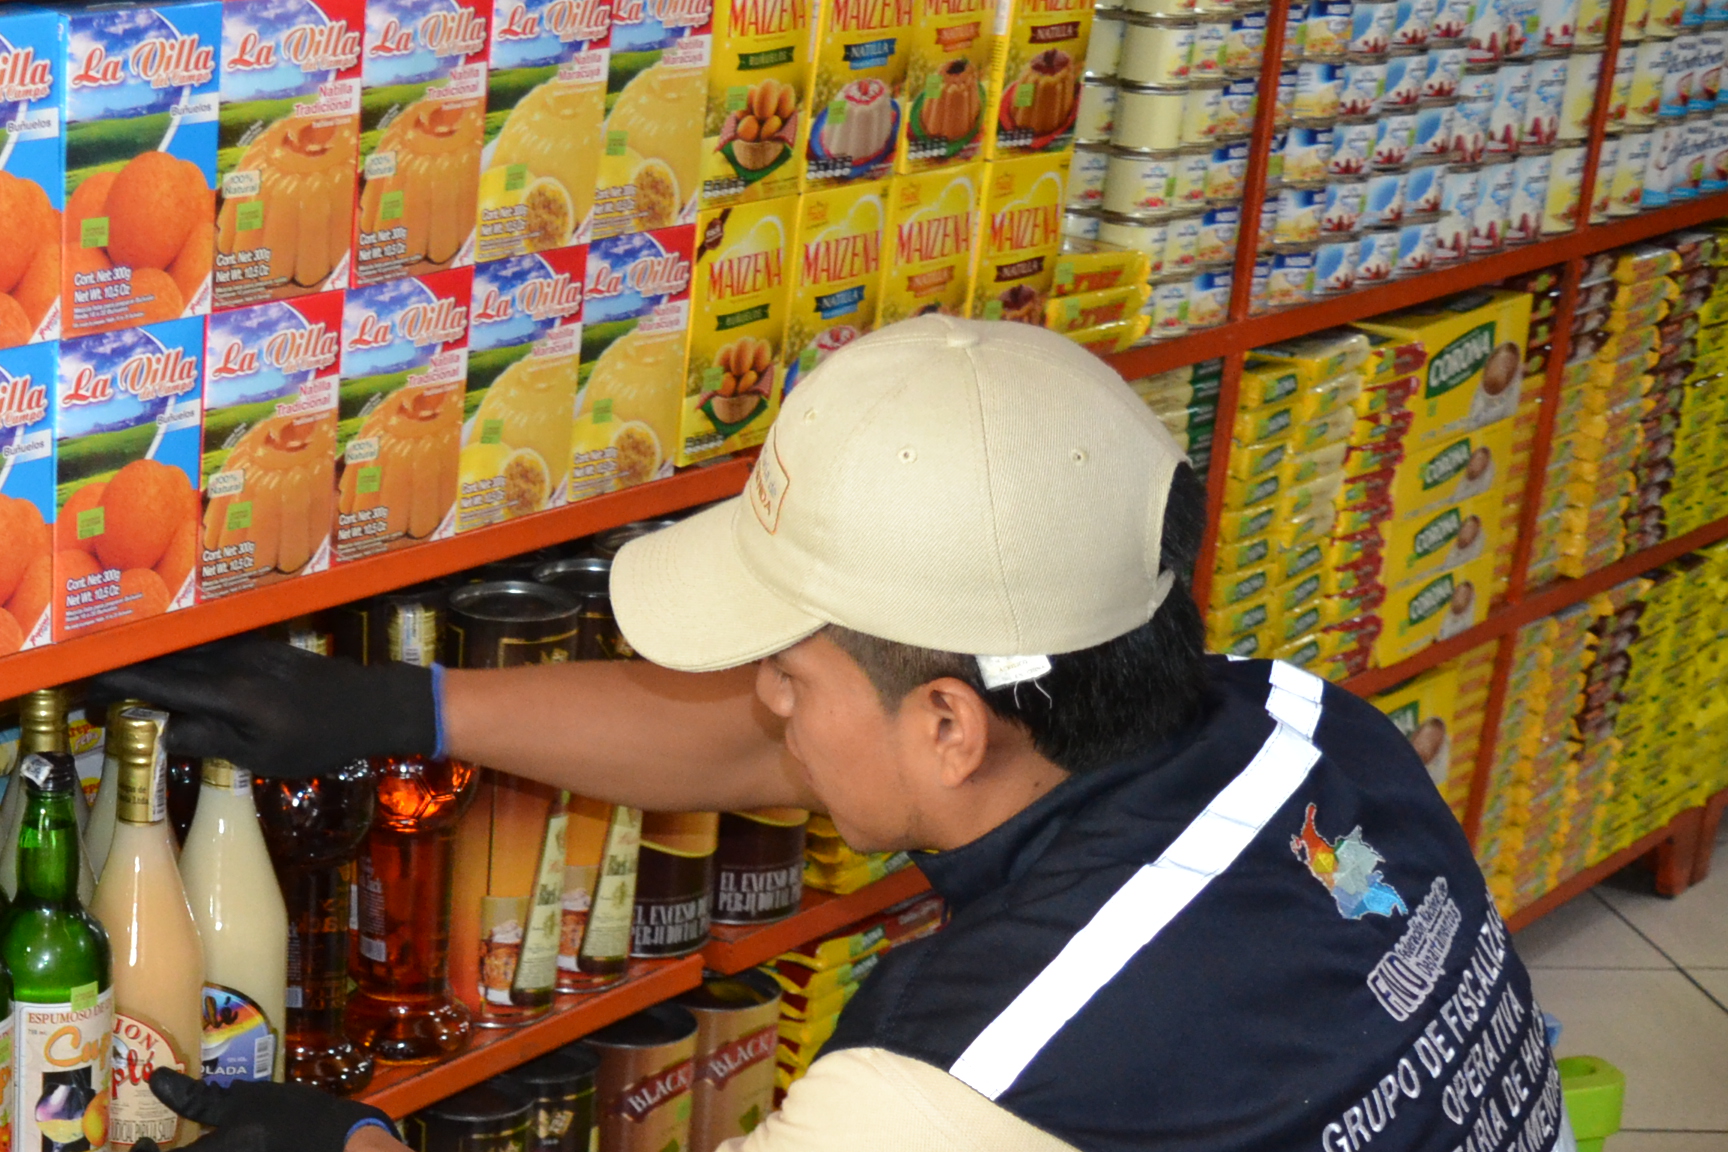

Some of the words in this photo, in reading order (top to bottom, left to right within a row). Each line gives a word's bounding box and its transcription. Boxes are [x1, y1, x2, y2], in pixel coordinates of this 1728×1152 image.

[372, 20, 413, 57] La
[419, 8, 486, 53] Villa
[497, 4, 539, 41] La
[544, 0, 612, 36] Villa
[728, 0, 806, 38] MAIZENA
[831, 0, 913, 32] MAIZENA
[72, 48, 124, 87] La
[129, 34, 214, 81] Villa
[227, 33, 275, 70] La
[282, 20, 361, 68] Villa
[318, 84, 354, 99] Natilla
[427, 82, 479, 100] Tradicional
[449, 67, 480, 83] Natilla
[7, 118, 52, 134] Buñuelos
[170, 102, 213, 118] Buñuelos
[294, 99, 353, 117] Tradicional
[224, 184, 259, 198] Natural
[895, 212, 970, 266] MAIZENA
[989, 203, 1062, 254] MAIZENA
[708, 247, 783, 301] MAIZENA
[801, 230, 879, 287] MAIZENA
[212, 341, 260, 380] La
[263, 322, 338, 366] Villa
[430, 352, 460, 368] Natilla
[1428, 331, 1490, 387] CORONA
[63, 367, 112, 406] La
[119, 347, 197, 394] Villa
[299, 380, 331, 396] Natilla
[408, 368, 459, 388] Tradicional
[157, 408, 194, 426] Buñuelos
[276, 394, 331, 416] Tradicional
[3, 440, 45, 458] Buñuelos
[28, 1010, 92, 1024] ESPUMOSO
[710, 1033, 771, 1077] BLACK
[1414, 1019, 1456, 1079] DE
[1442, 982, 1525, 1126] OPERATIVA
[628, 1069, 688, 1113] BLACK
[1501, 1060, 1530, 1118] DE
